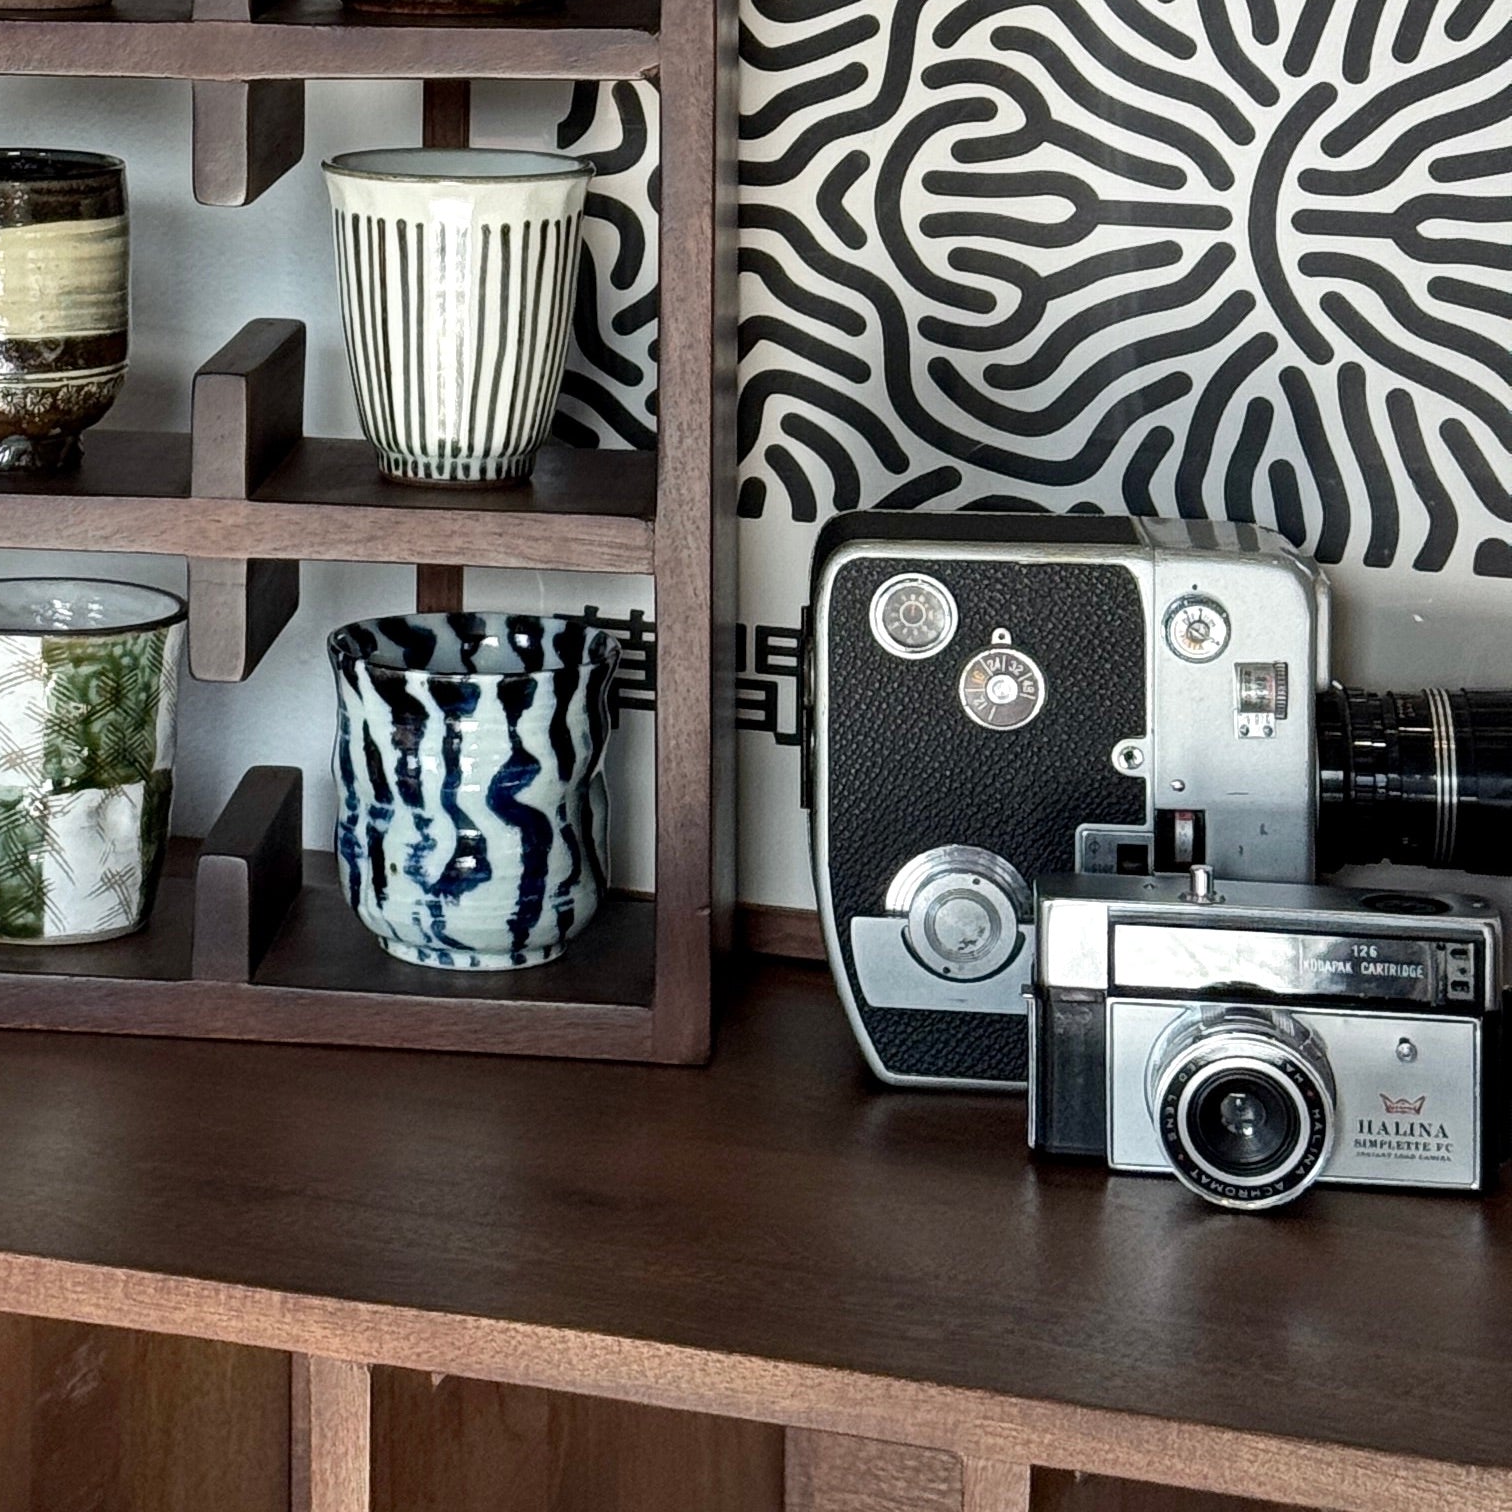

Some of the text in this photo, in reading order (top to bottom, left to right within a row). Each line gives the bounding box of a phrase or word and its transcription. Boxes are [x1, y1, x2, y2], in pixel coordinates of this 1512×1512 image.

[1351, 944, 1378, 959] 126
[1303, 959, 1424, 979] KODAPAK CARTRIDGE
[1358, 1119, 1449, 1139] HALINA
[1190, 1108, 1324, 1199] HALINA ACHROMAT
[1353, 1138, 1431, 1152] SIMPLETTE
